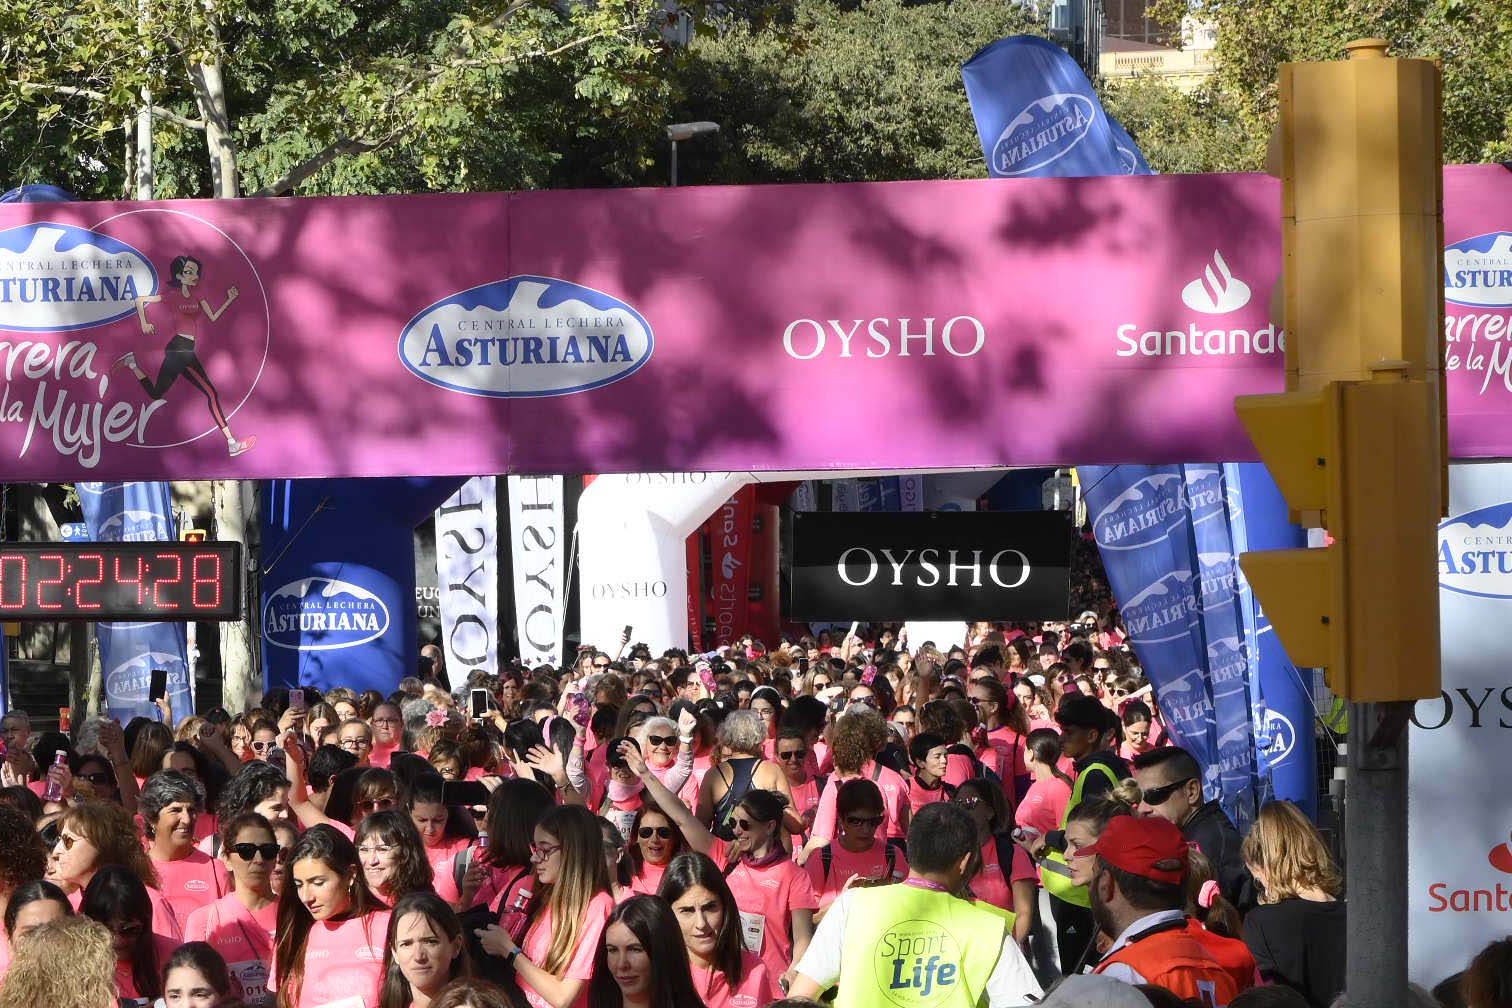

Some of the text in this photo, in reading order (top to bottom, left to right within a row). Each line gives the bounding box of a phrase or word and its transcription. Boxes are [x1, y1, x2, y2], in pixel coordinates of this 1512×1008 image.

[60, 258, 134, 271] LECHERA
[458, 317, 625, 331] CENTRAL LECHERA
[782, 315, 986, 359] OYSHO
[419, 323, 634, 367] ASTURIANA
[0, 384, 24, 423] la
[19, 373, 168, 469] Mujer
[0, 554, 220, 609] 02:24:28
[837, 548, 1032, 588] OYSHO
[267, 610, 381, 634] ASTURIANA
[326, 601, 376, 609] LECHERA
[882, 932, 948, 961] Sport
[890, 955, 957, 996] Life
